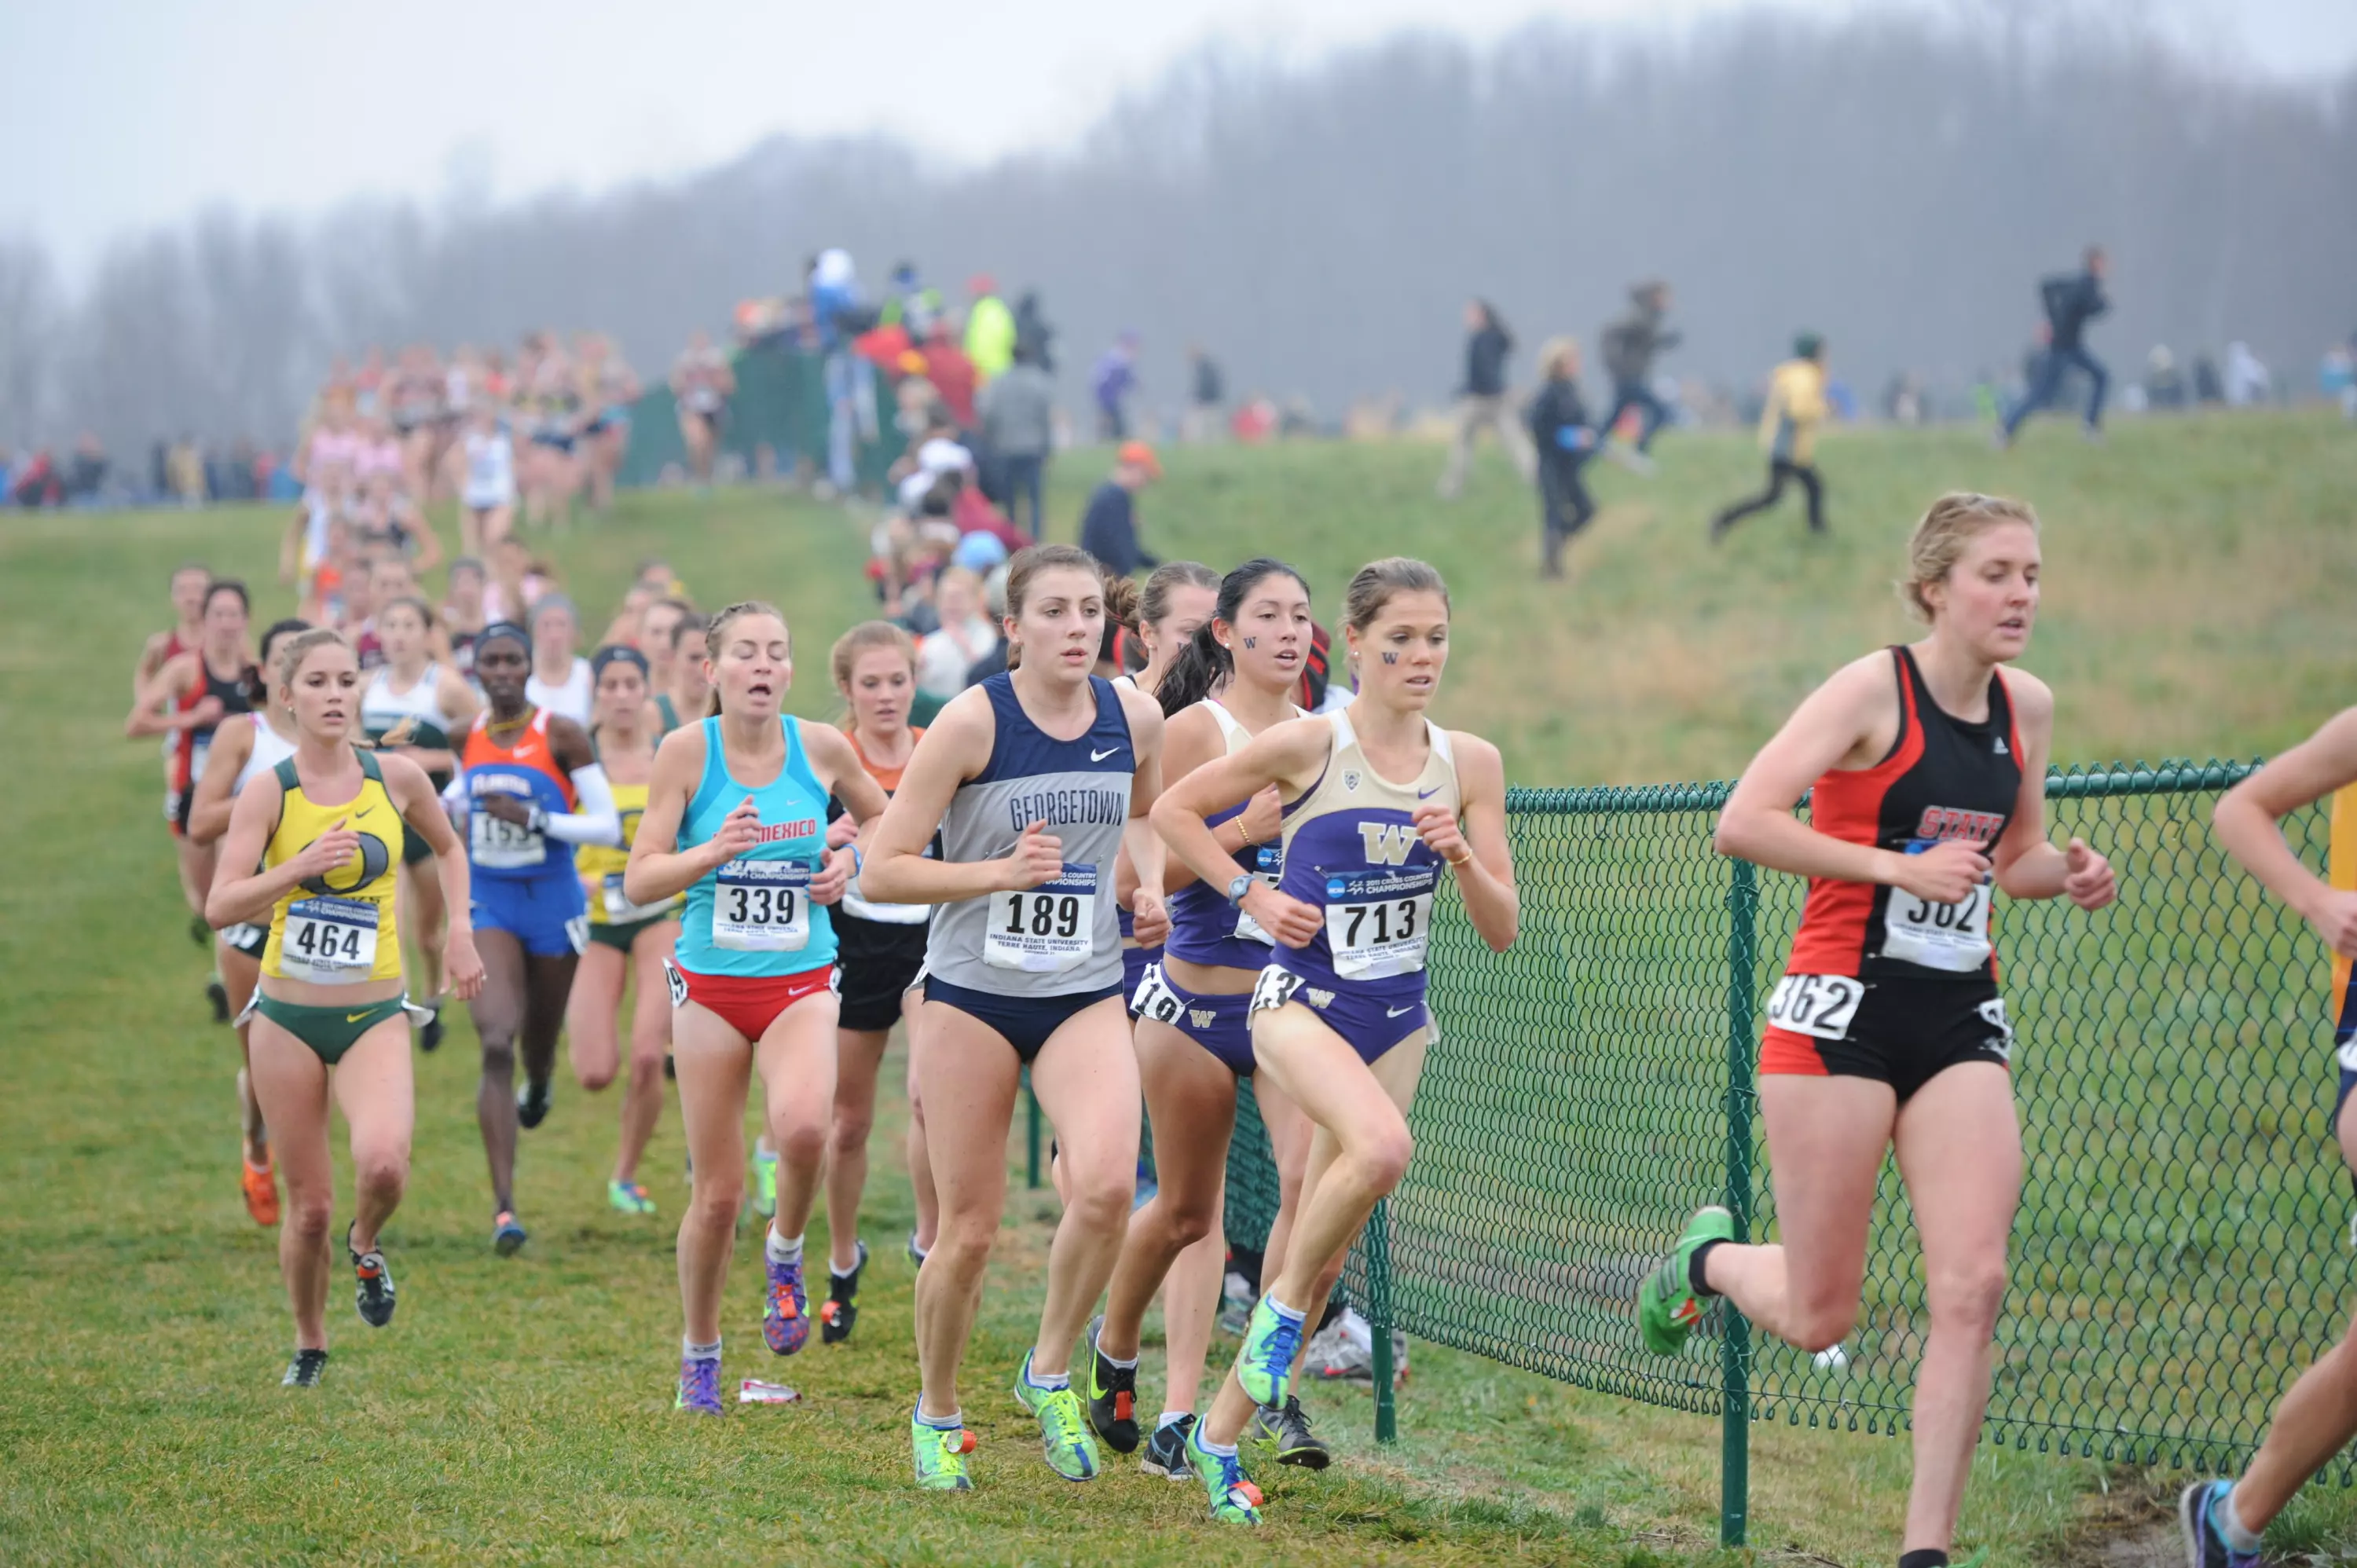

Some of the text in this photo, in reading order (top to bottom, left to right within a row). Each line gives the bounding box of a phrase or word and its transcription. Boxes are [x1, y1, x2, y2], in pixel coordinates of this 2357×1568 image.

[1243, 636, 1257, 650] W
[1381, 651, 1399, 665] W
[1010, 789, 1124, 832] GEORGETOWN
[756, 819, 816, 844] MEXICO
[1916, 805, 2006, 843] STATE
[1358, 821, 1424, 866] W
[1365, 877, 1434, 895] CHAMPIONSHIPS
[1403, 872, 1433, 881] COUNTRY
[729, 888, 794, 925] 339
[1006, 893, 1080, 938] 189
[1344, 899, 1417, 947] 713
[296, 921, 361, 961] 464
[989, 932, 1023, 943] INDIANA
[1025, 936, 1046, 945] STATE
[997, 940, 1021, 949] TERRE
[1307, 987, 1336, 1009] W
[1772, 975, 1853, 1032] 362
[1188, 1009, 1217, 1028] W
